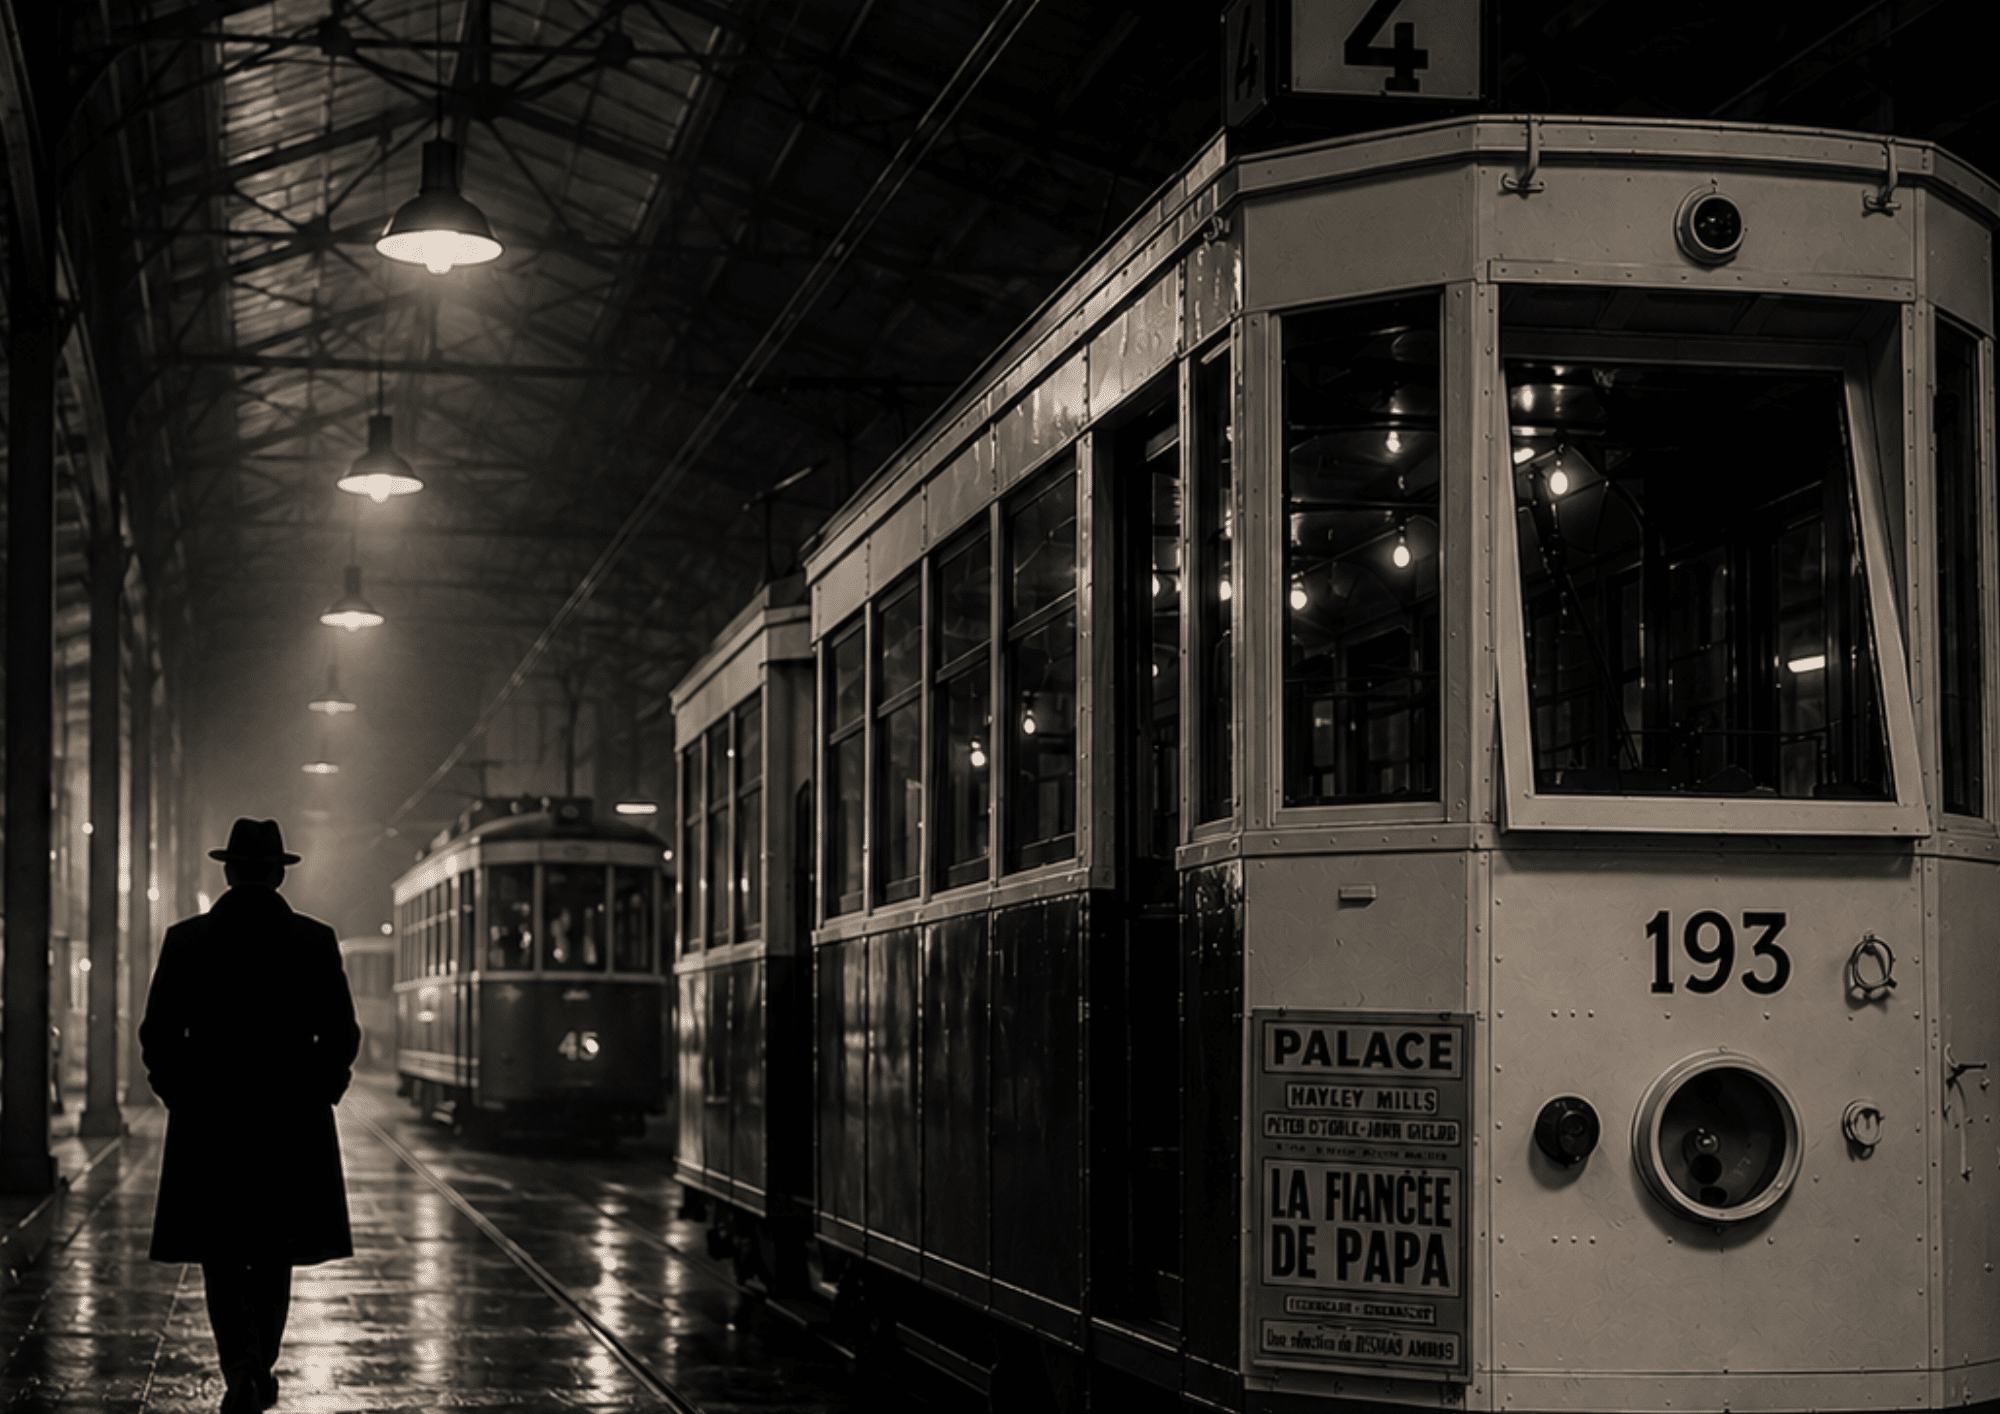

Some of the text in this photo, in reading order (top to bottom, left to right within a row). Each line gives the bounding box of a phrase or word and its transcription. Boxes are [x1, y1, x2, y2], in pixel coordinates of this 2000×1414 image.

[1344, 0, 1428, 91] 4
[1646, 910, 1790, 994] 193
[1273, 1028, 1452, 1070] PALACE
[1291, 1087, 1435, 1112] HAYLEY MILLS
[1272, 1168, 1310, 1220] LA
[1272, 1224, 1450, 1288] DE PAPA
